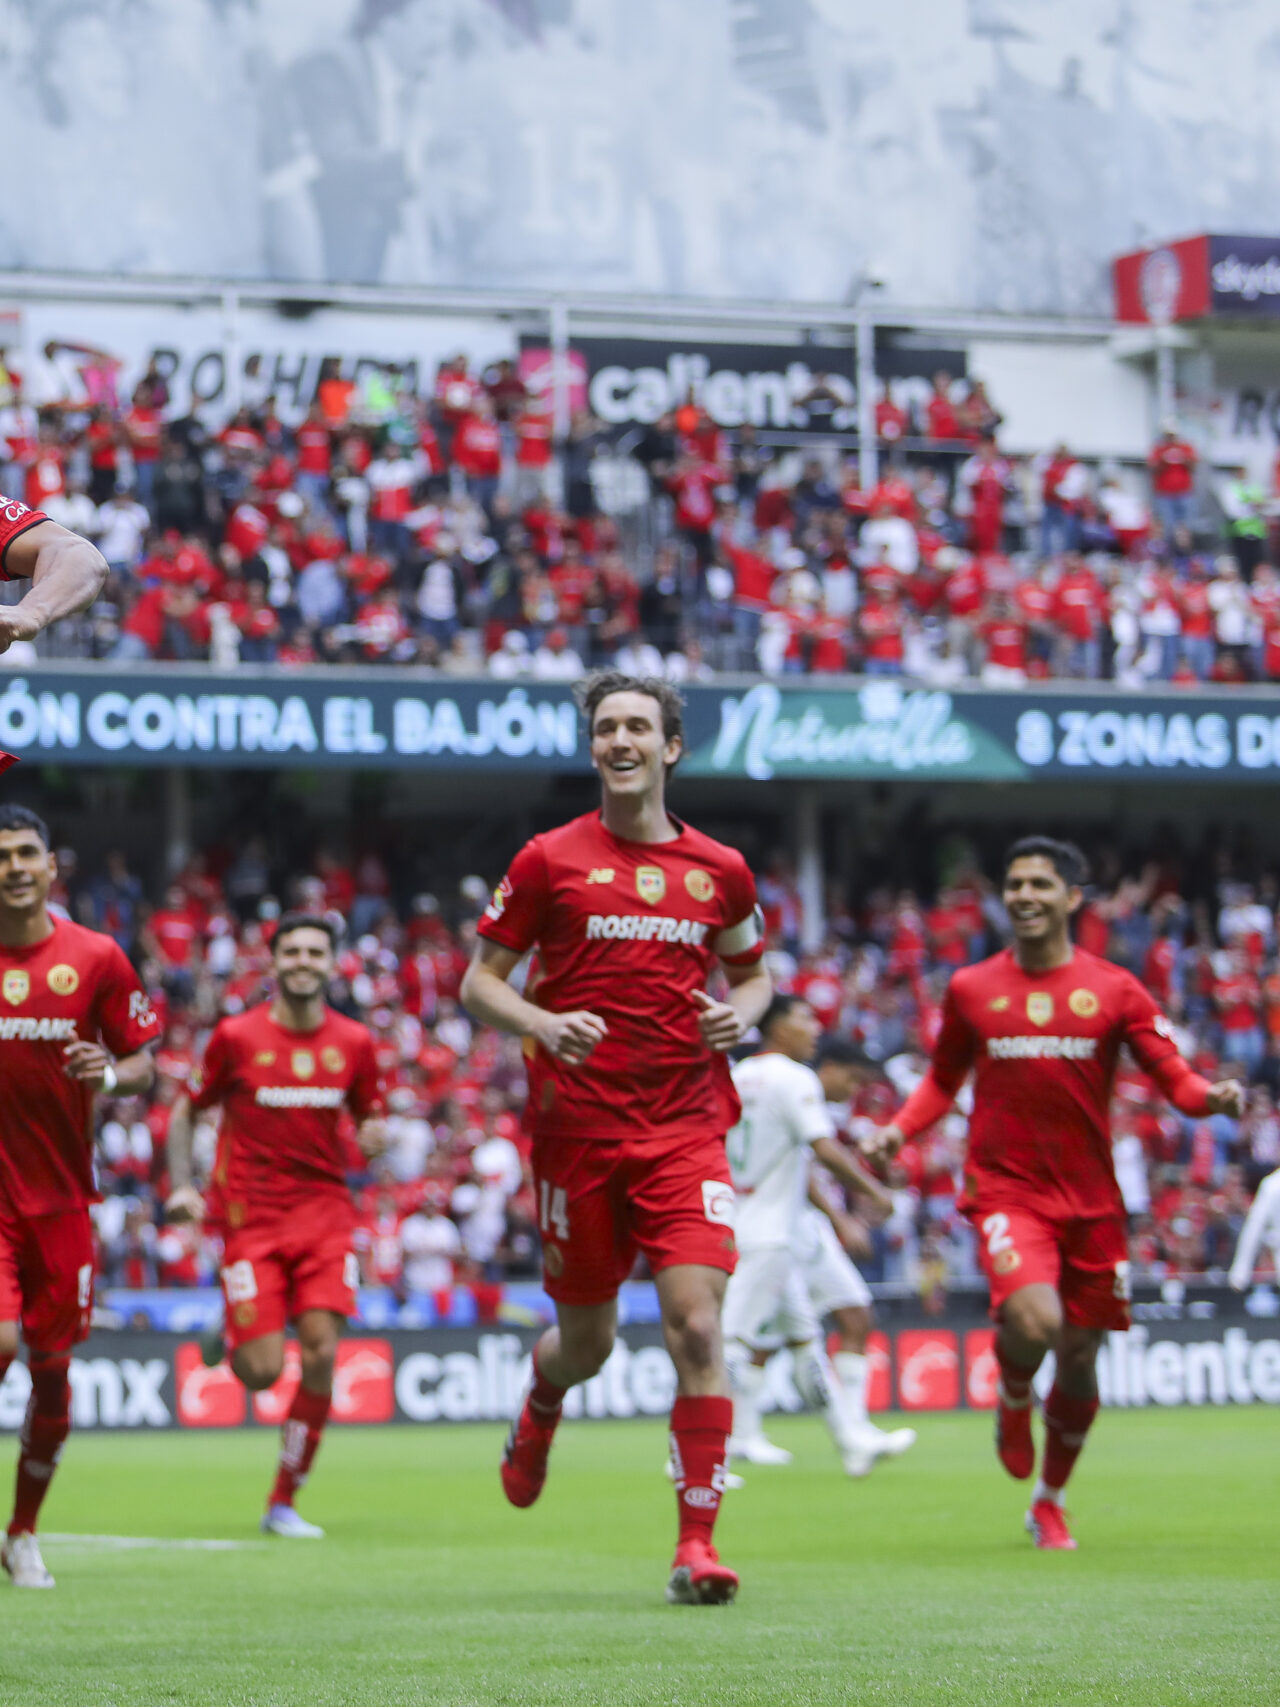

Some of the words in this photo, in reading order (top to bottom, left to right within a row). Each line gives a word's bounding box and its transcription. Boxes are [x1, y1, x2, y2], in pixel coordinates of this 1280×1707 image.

[86, 690, 318, 753] CONTRA
[323, 696, 388, 754] EL
[394, 687, 578, 758] BAJÓN
[1016, 709, 1053, 767] 8
[1057, 711, 1232, 769] ZONAS
[587, 914, 709, 945] ROSHFRAN
[983, 1212, 1015, 1255] 2
